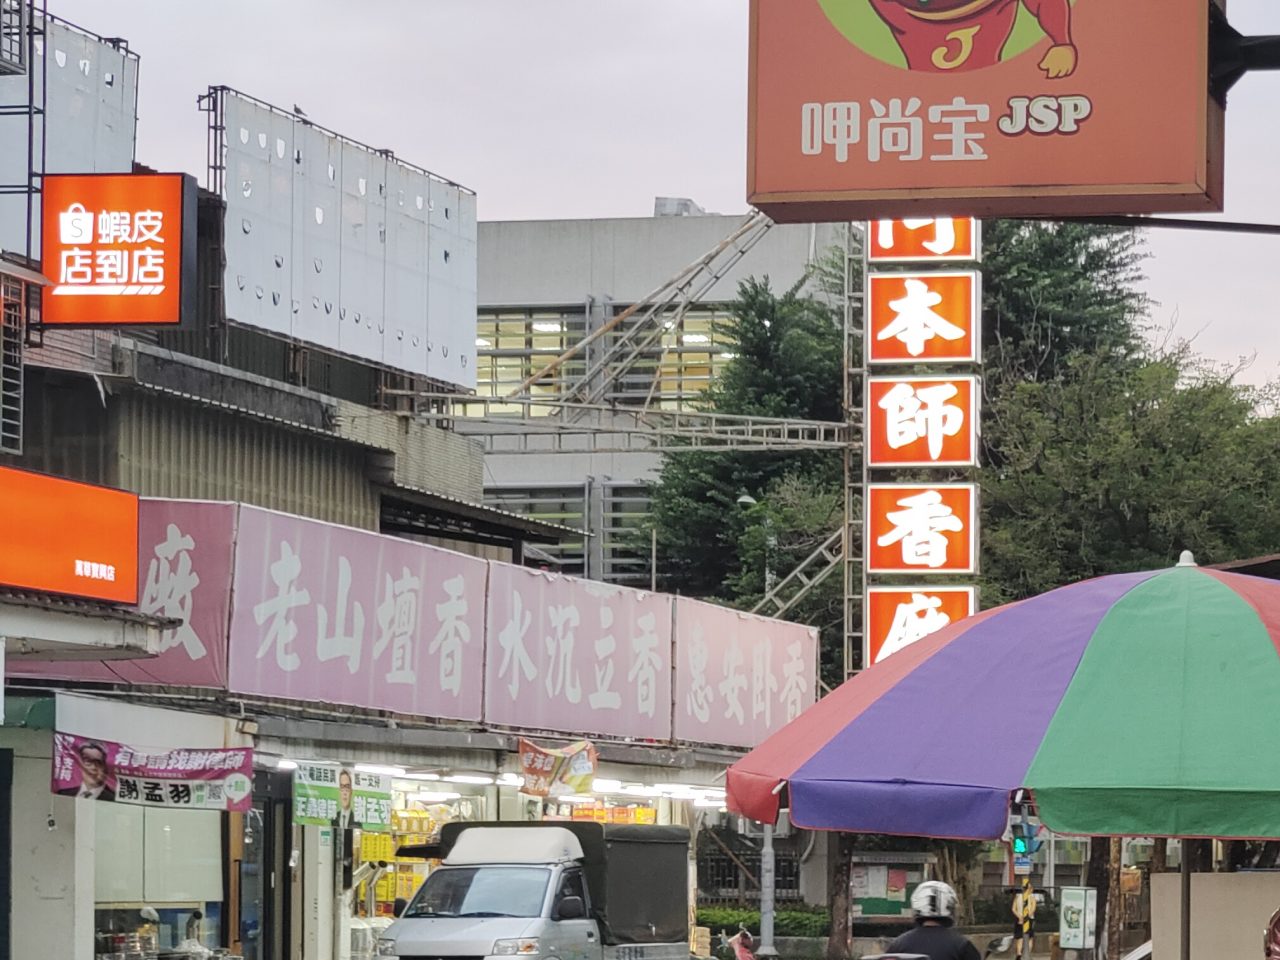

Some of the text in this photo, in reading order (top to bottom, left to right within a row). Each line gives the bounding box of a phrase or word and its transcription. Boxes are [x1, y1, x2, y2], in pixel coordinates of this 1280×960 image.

[801, 97, 991, 163] 呷尚宝
[997, 95, 1092, 136] JSP
[97, 209, 165, 244] 蝦皮
[60, 246, 165, 284] 店到店
[253, 540, 471, 697] 老山壇香
[118, 777, 192, 804] 謝孟羽
